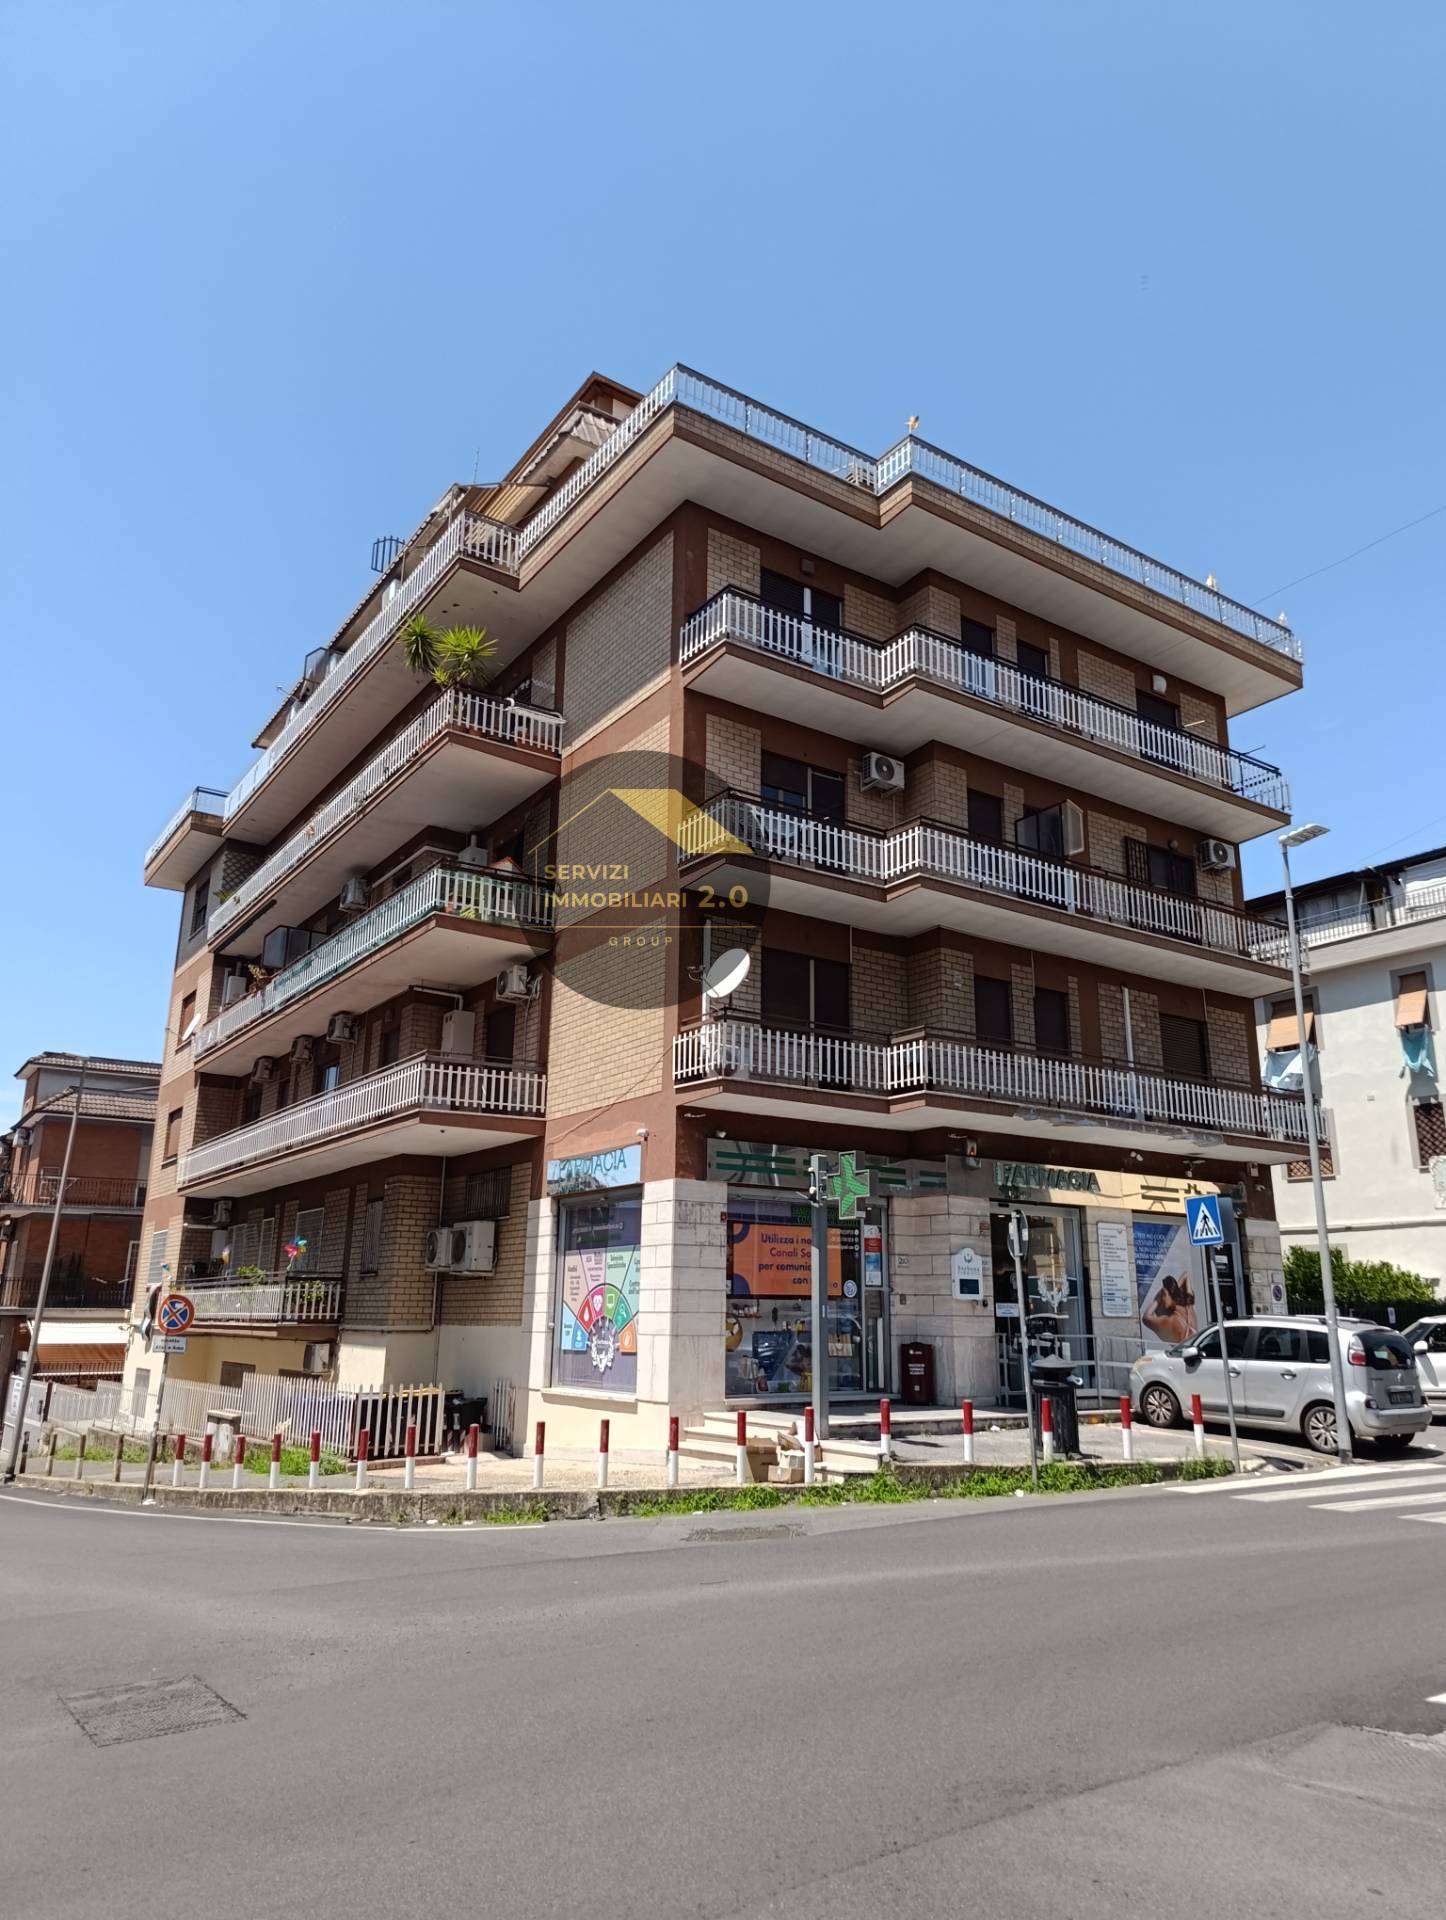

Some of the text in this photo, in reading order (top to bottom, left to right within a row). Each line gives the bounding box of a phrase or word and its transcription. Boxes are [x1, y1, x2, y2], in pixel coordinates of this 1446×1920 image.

[995, 1162, 1101, 1192] FARMACIA
[760, 1233, 794, 1245] Utilizza
[769, 1247, 798, 1258] Canali
[758, 1262, 812, 1273] per comunic
[792, 1277, 808, 1285] con
